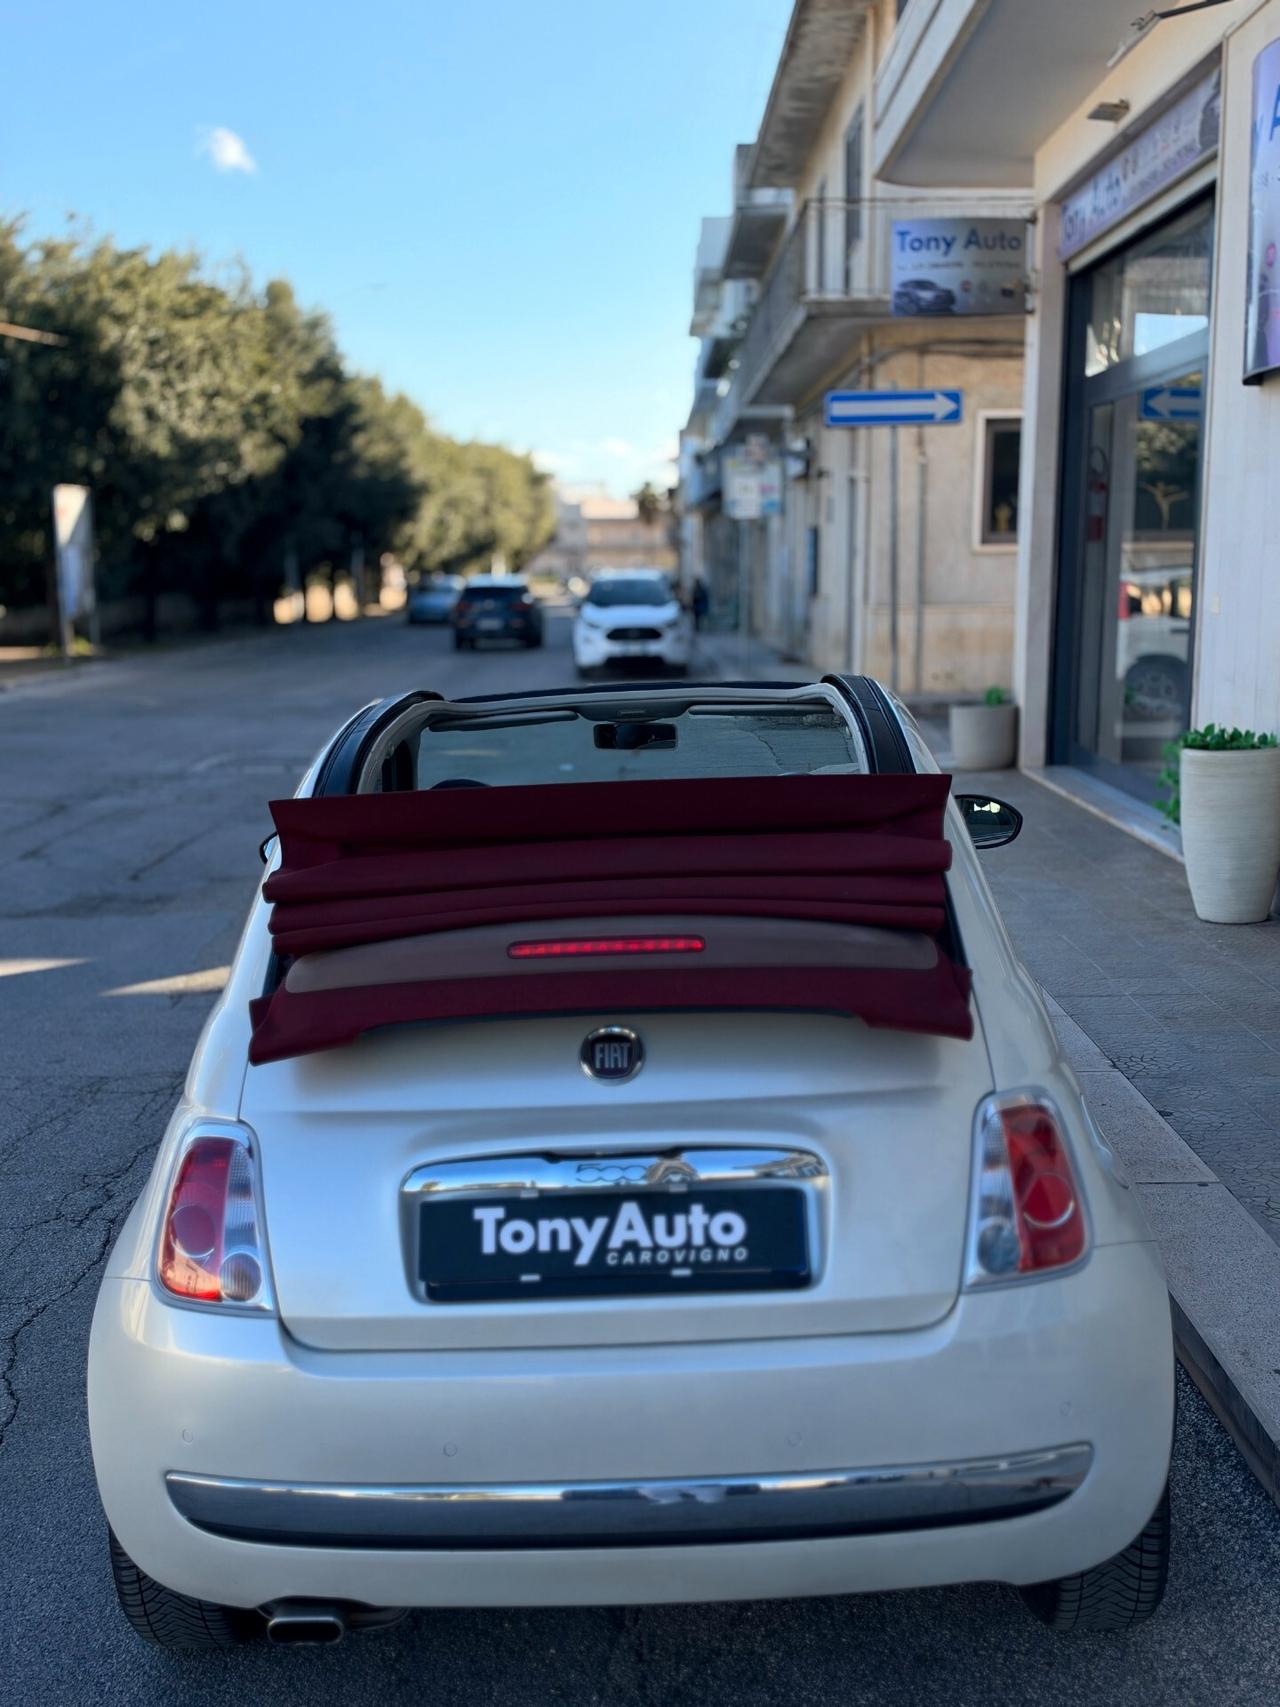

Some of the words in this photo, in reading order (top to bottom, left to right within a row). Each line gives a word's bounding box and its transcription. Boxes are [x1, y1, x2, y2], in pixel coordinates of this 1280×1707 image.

[896, 229, 955, 257] Tony
[964, 228, 1022, 250] Auto
[595, 1042, 631, 1069] FIAT
[576, 1162, 650, 1183] 500
[606, 1248, 748, 1266] CAROVIGNO
